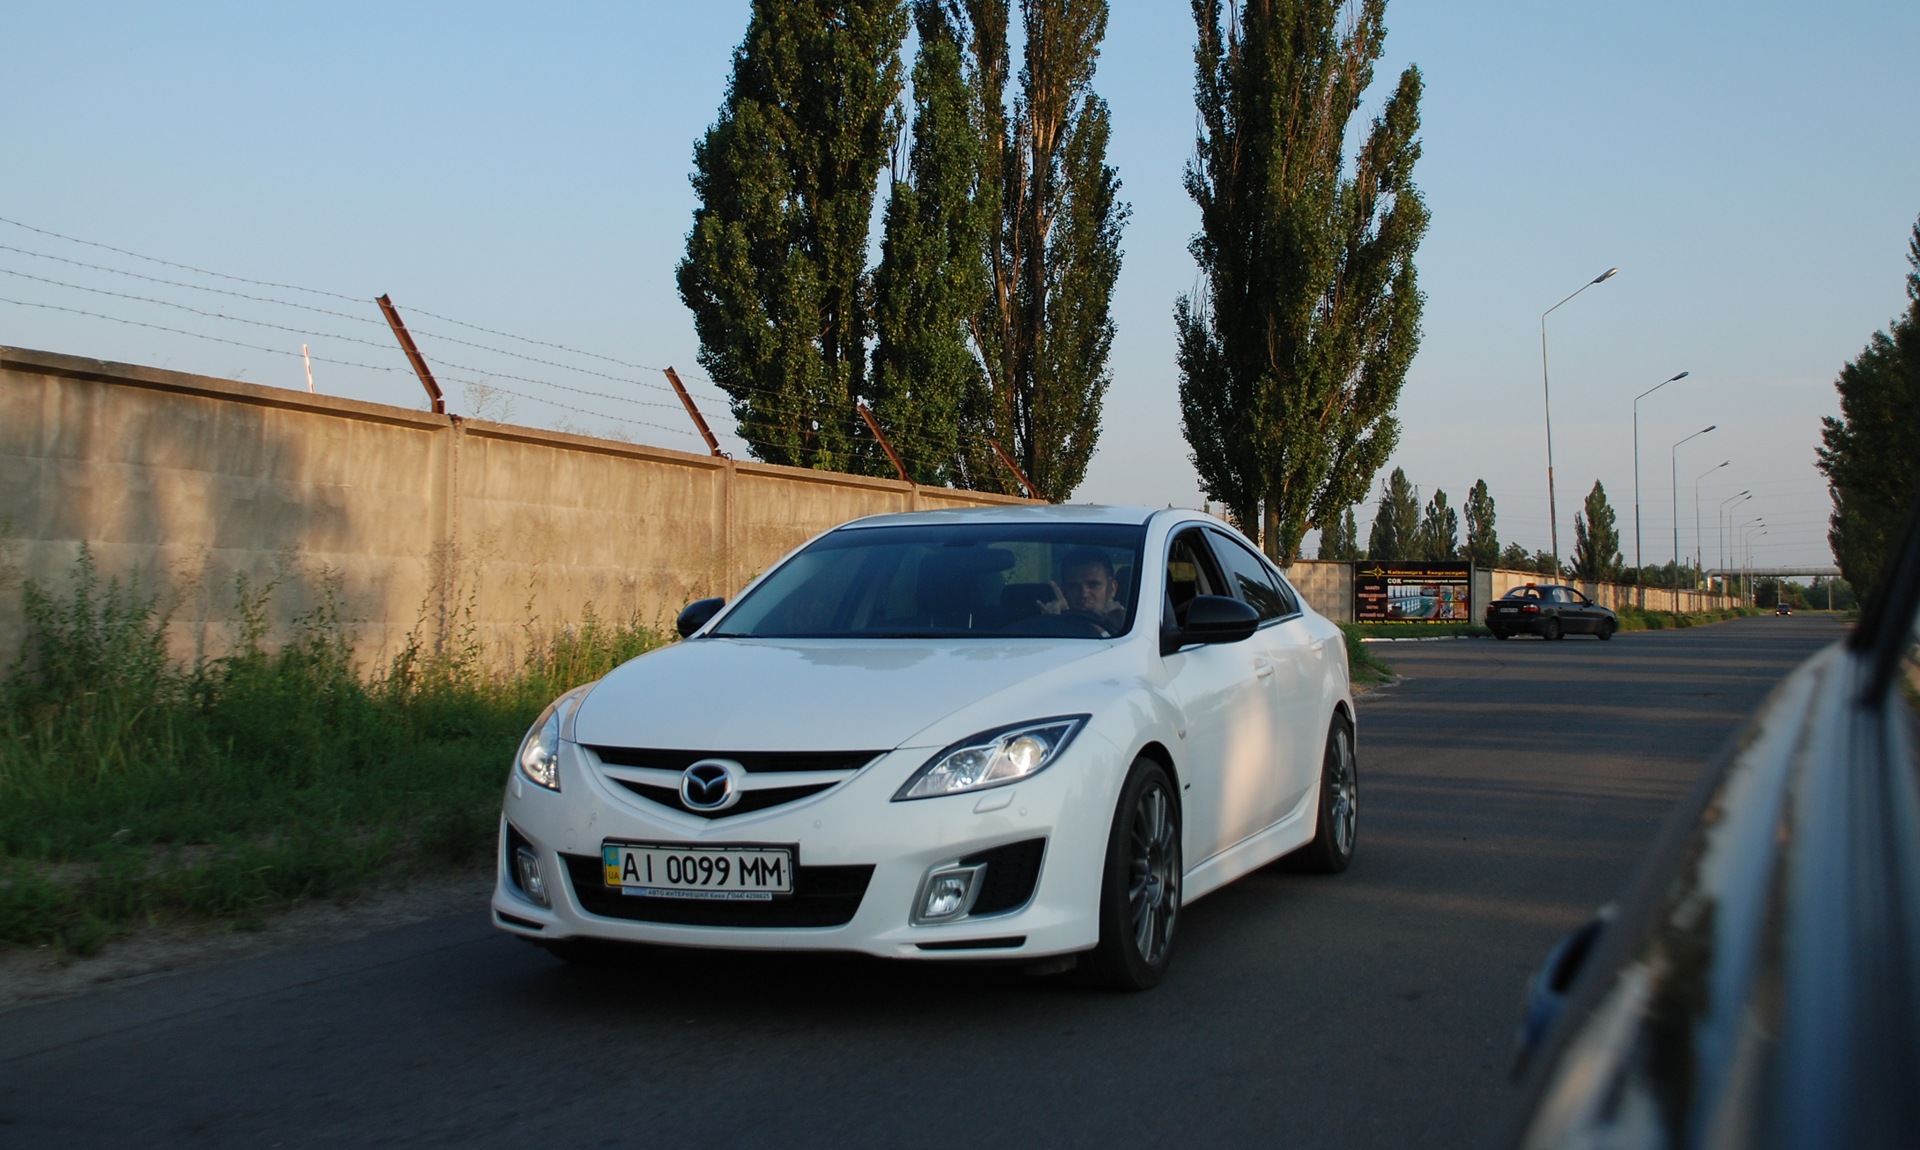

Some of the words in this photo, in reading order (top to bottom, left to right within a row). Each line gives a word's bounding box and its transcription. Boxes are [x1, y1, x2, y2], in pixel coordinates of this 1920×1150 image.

[608, 871, 620, 880] UA
[622, 852, 652, 883] AI
[666, 855, 731, 885] 0099
[739, 856, 782, 886] MM
